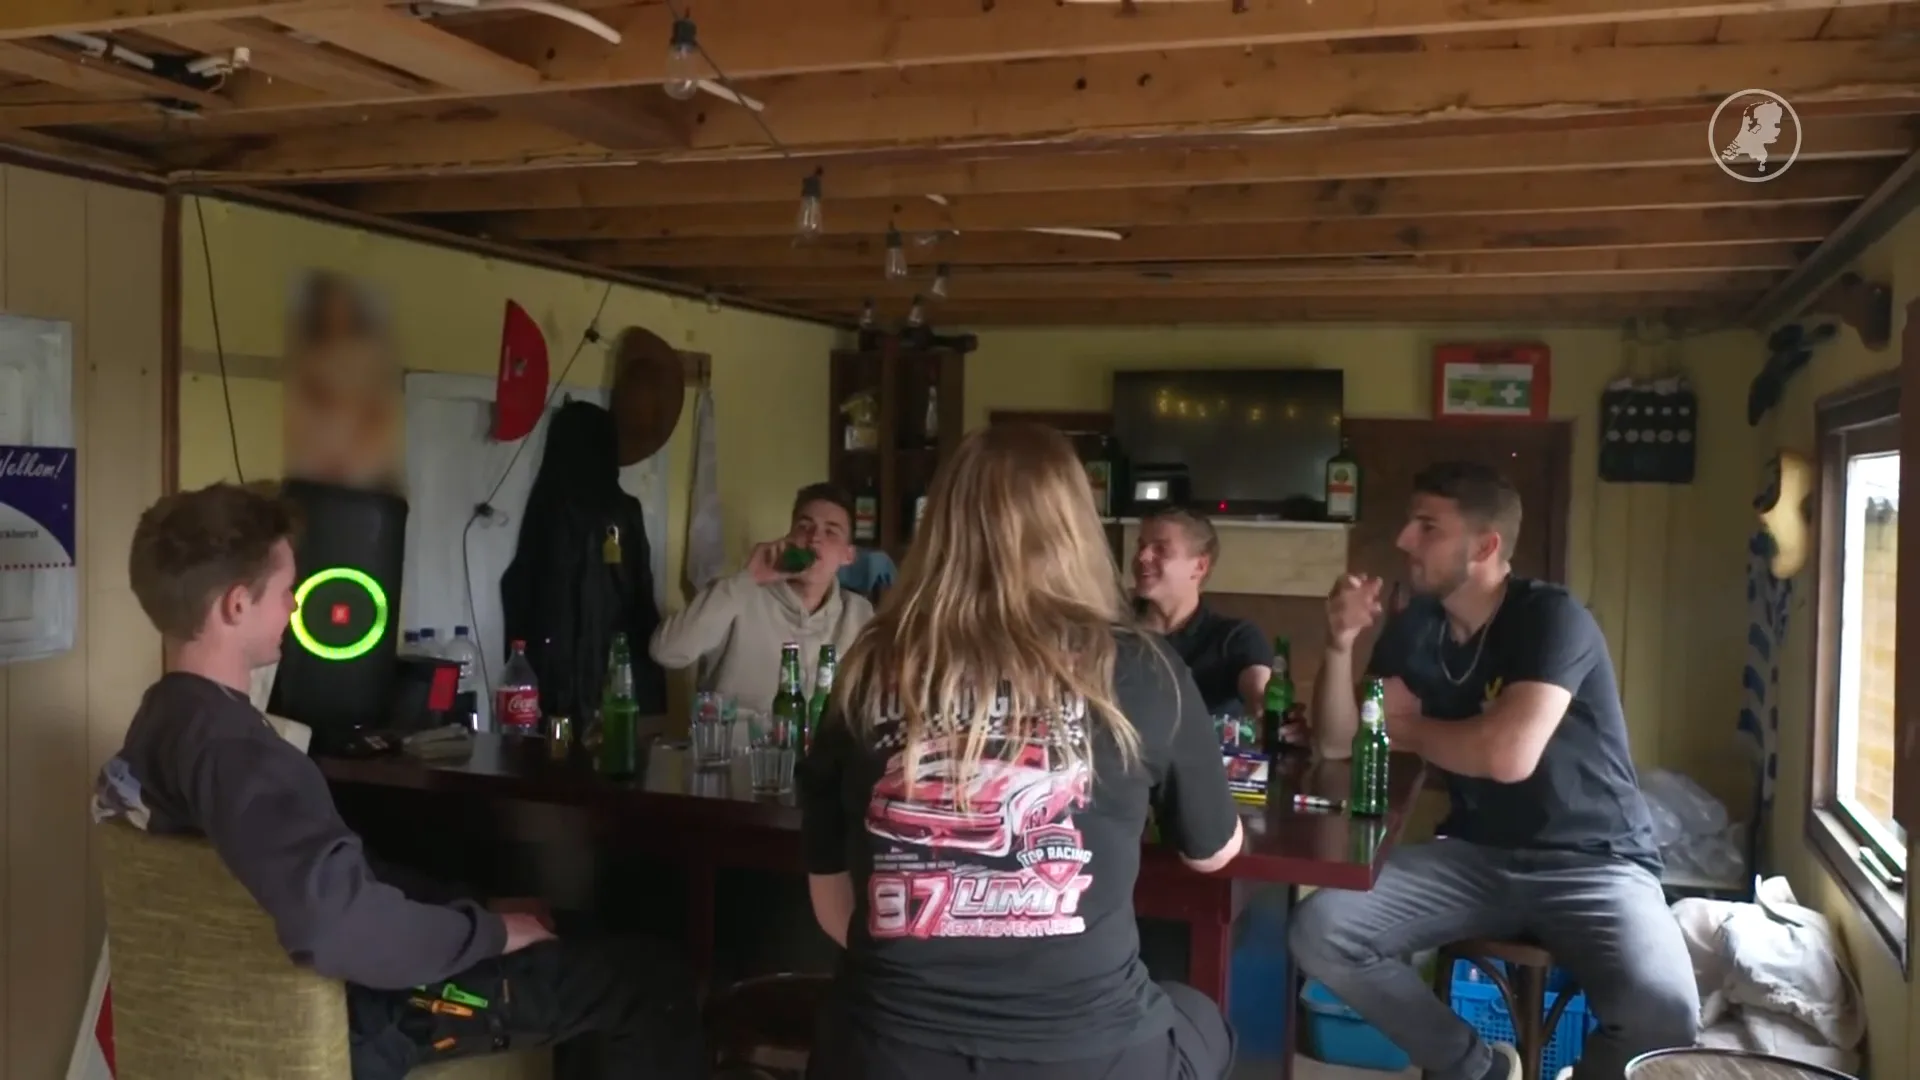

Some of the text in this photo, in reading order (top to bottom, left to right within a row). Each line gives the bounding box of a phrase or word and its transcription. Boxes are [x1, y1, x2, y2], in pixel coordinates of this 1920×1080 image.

[1018, 846, 1093, 867] TOP RACING
[951, 874, 1093, 916] LIMIT
